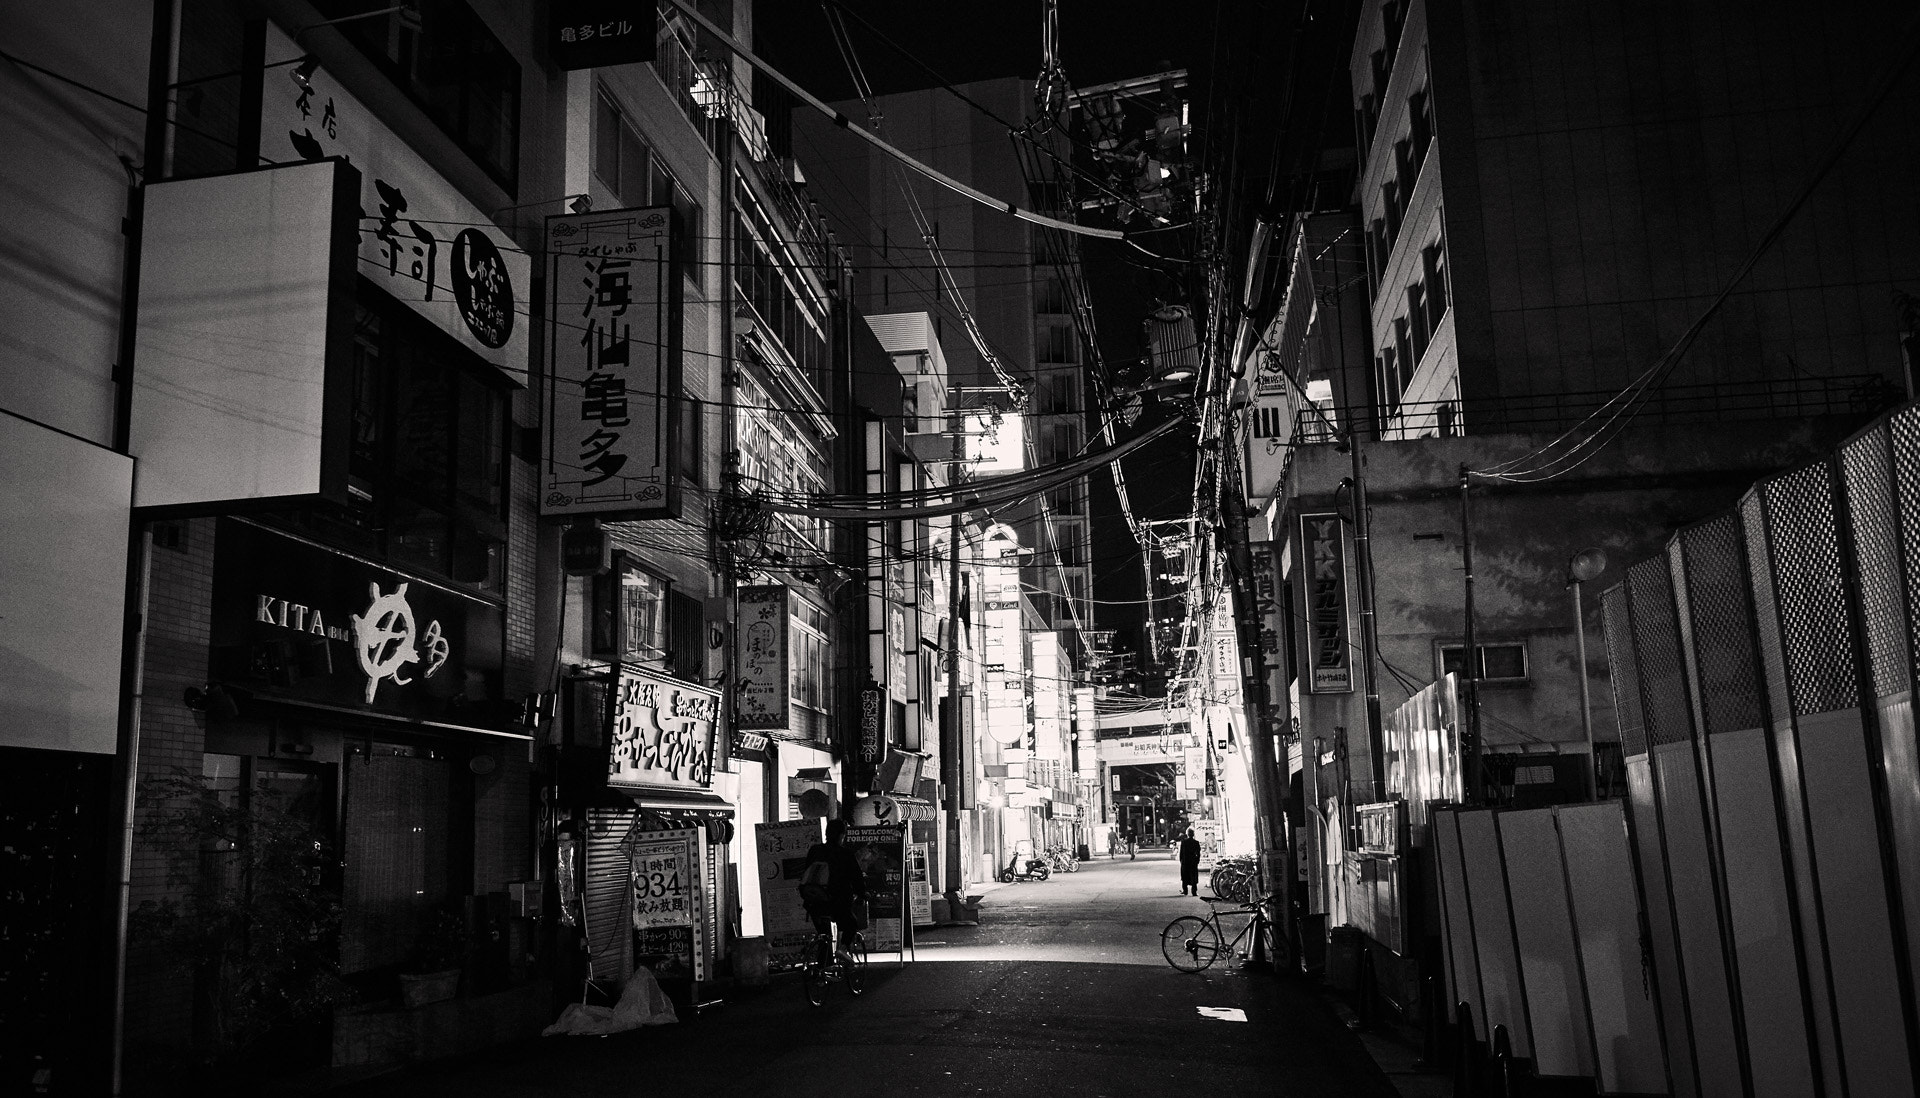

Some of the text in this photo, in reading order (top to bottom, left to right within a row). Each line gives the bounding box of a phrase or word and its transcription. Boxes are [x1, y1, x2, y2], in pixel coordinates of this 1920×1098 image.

[560, 20, 632, 42] 亀多ビル
[297, 87, 336, 139] 本店
[579, 242, 637, 257] タイしゃぶ
[580, 258, 632, 487] 海仙亀多
[256, 594, 325, 637] KITA
